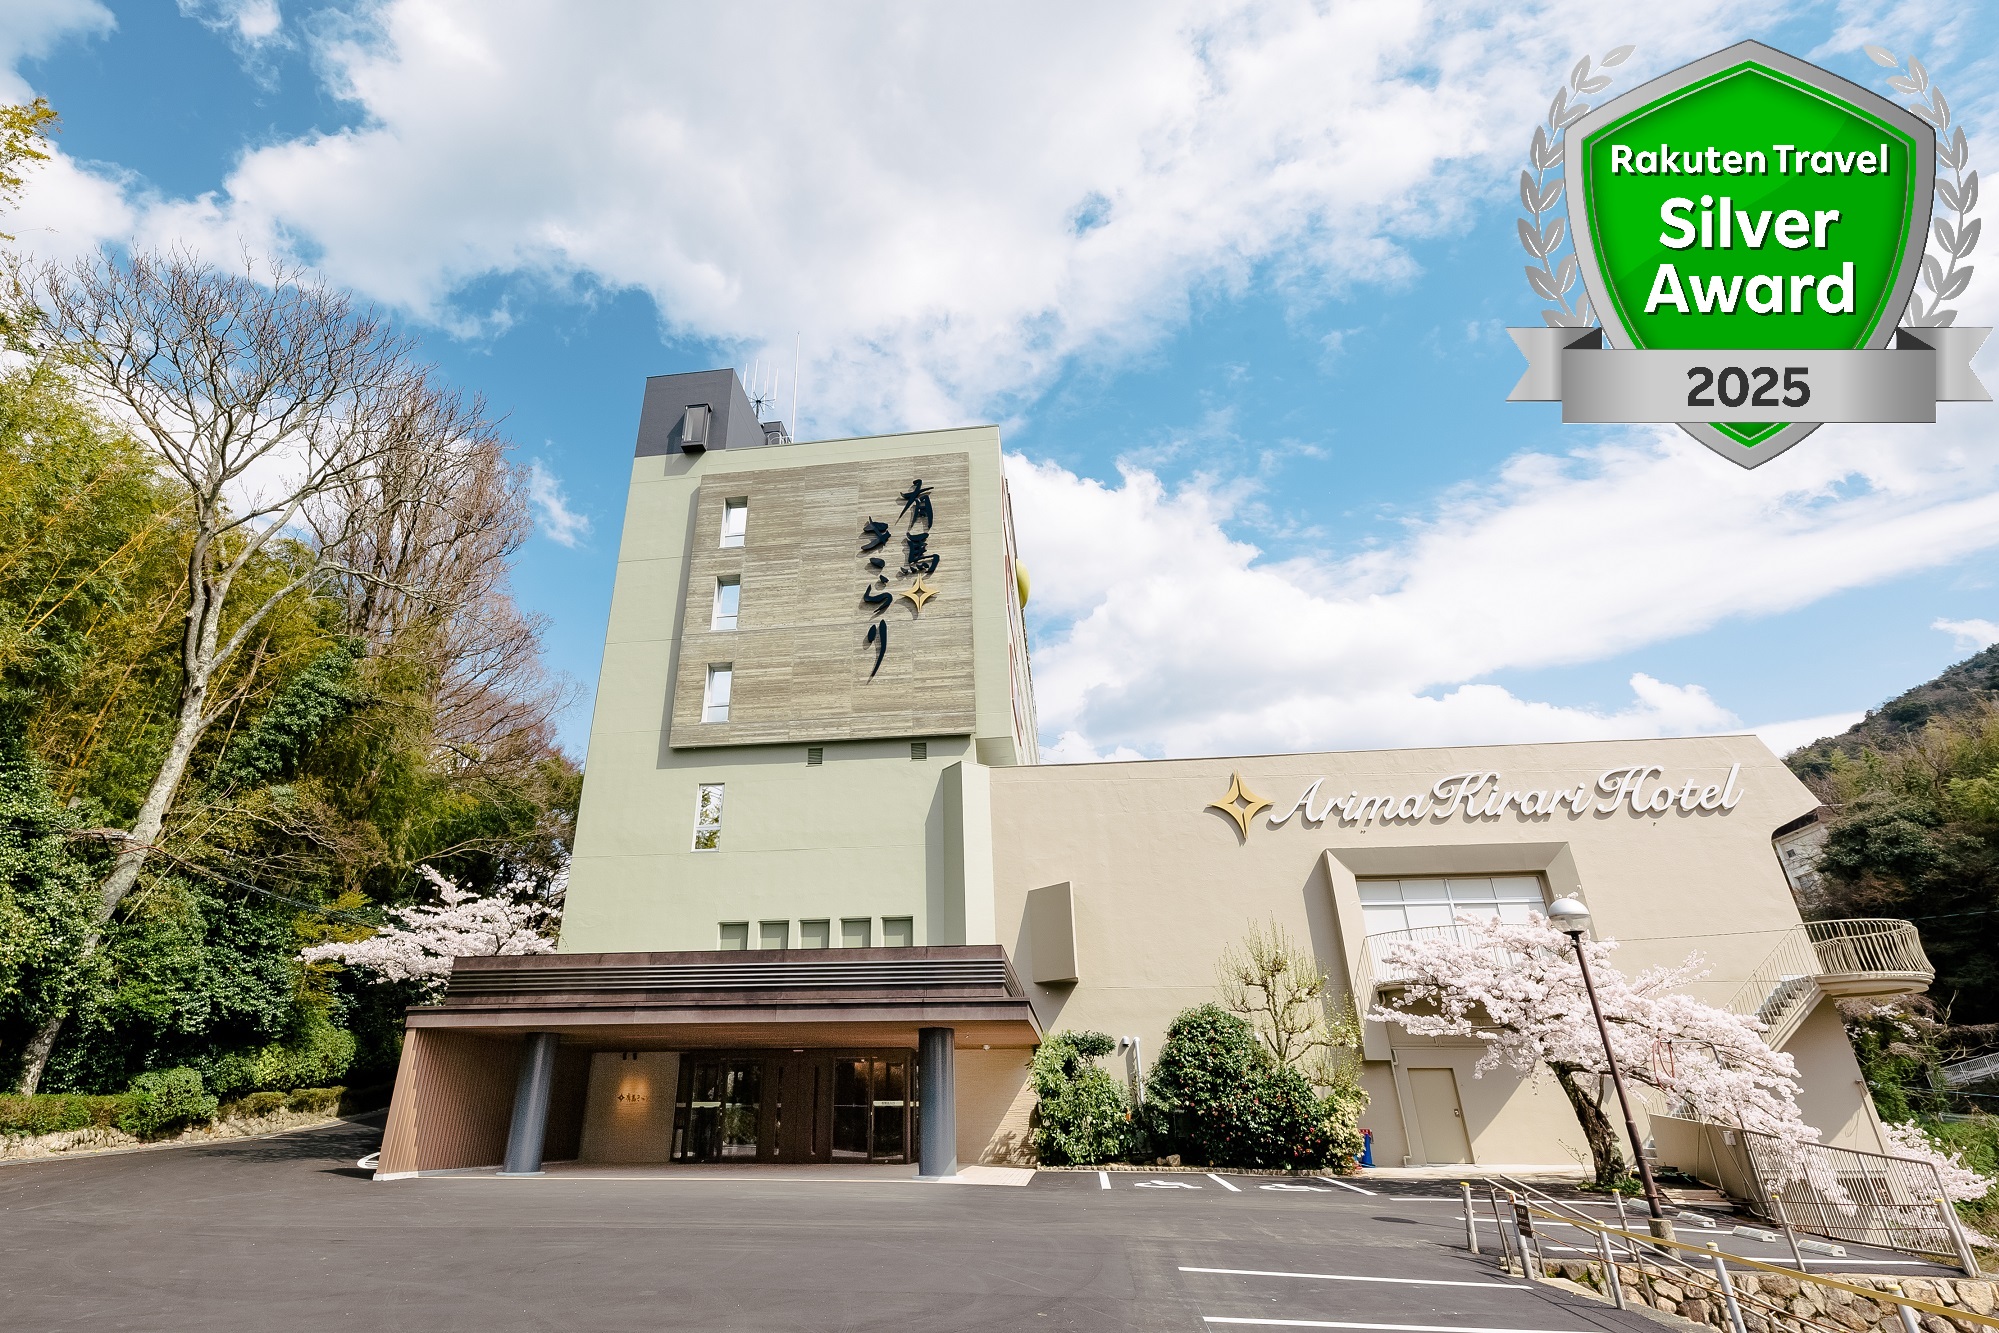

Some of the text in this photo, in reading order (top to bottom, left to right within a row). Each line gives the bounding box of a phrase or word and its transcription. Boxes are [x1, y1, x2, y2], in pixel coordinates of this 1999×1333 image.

[896, 479, 940, 574] 有馬
[861, 516, 893, 685] きらり
[1269, 763, 1745, 825] Arima Kirari Hotel
